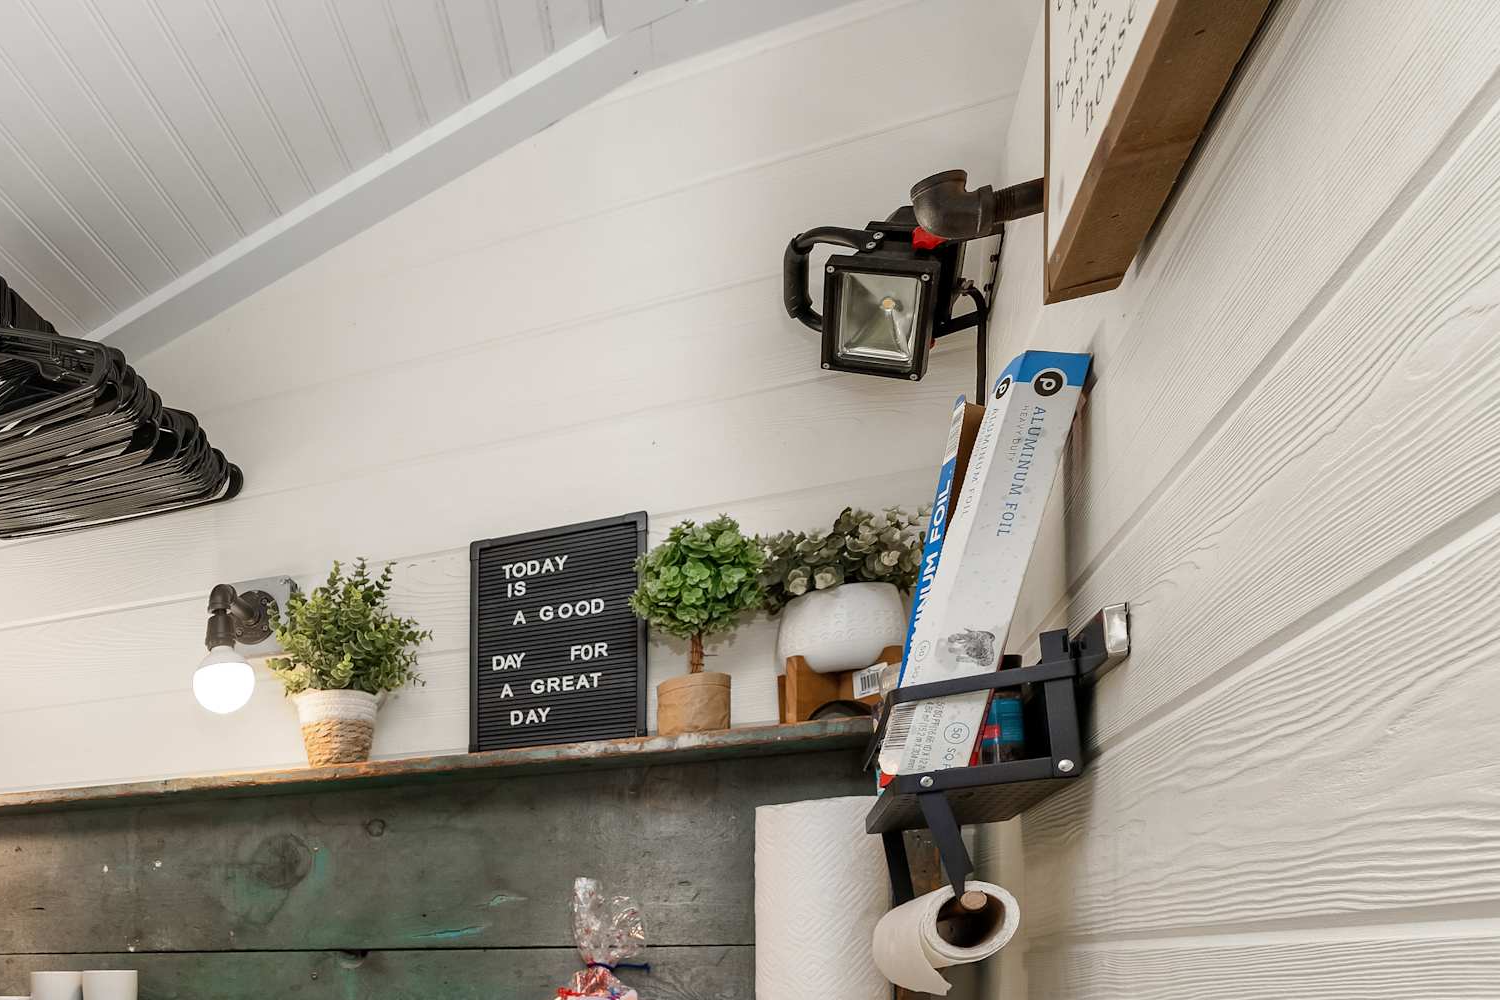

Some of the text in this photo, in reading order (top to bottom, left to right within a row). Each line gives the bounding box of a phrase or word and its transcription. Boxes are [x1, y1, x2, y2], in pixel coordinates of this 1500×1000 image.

[996, 406, 1047, 537] ALUMINUM FOIL
[929, 480, 951, 544] FOIL
[502, 555, 569, 579] TODAY
[507, 581, 527, 598] IS
[512, 598, 605, 625] A GOOD
[492, 642, 609, 671] DAY FOR
[500, 672, 603, 699] A GREAT
[510, 707, 551, 726] DAY
[951, 728, 963, 739] 50
